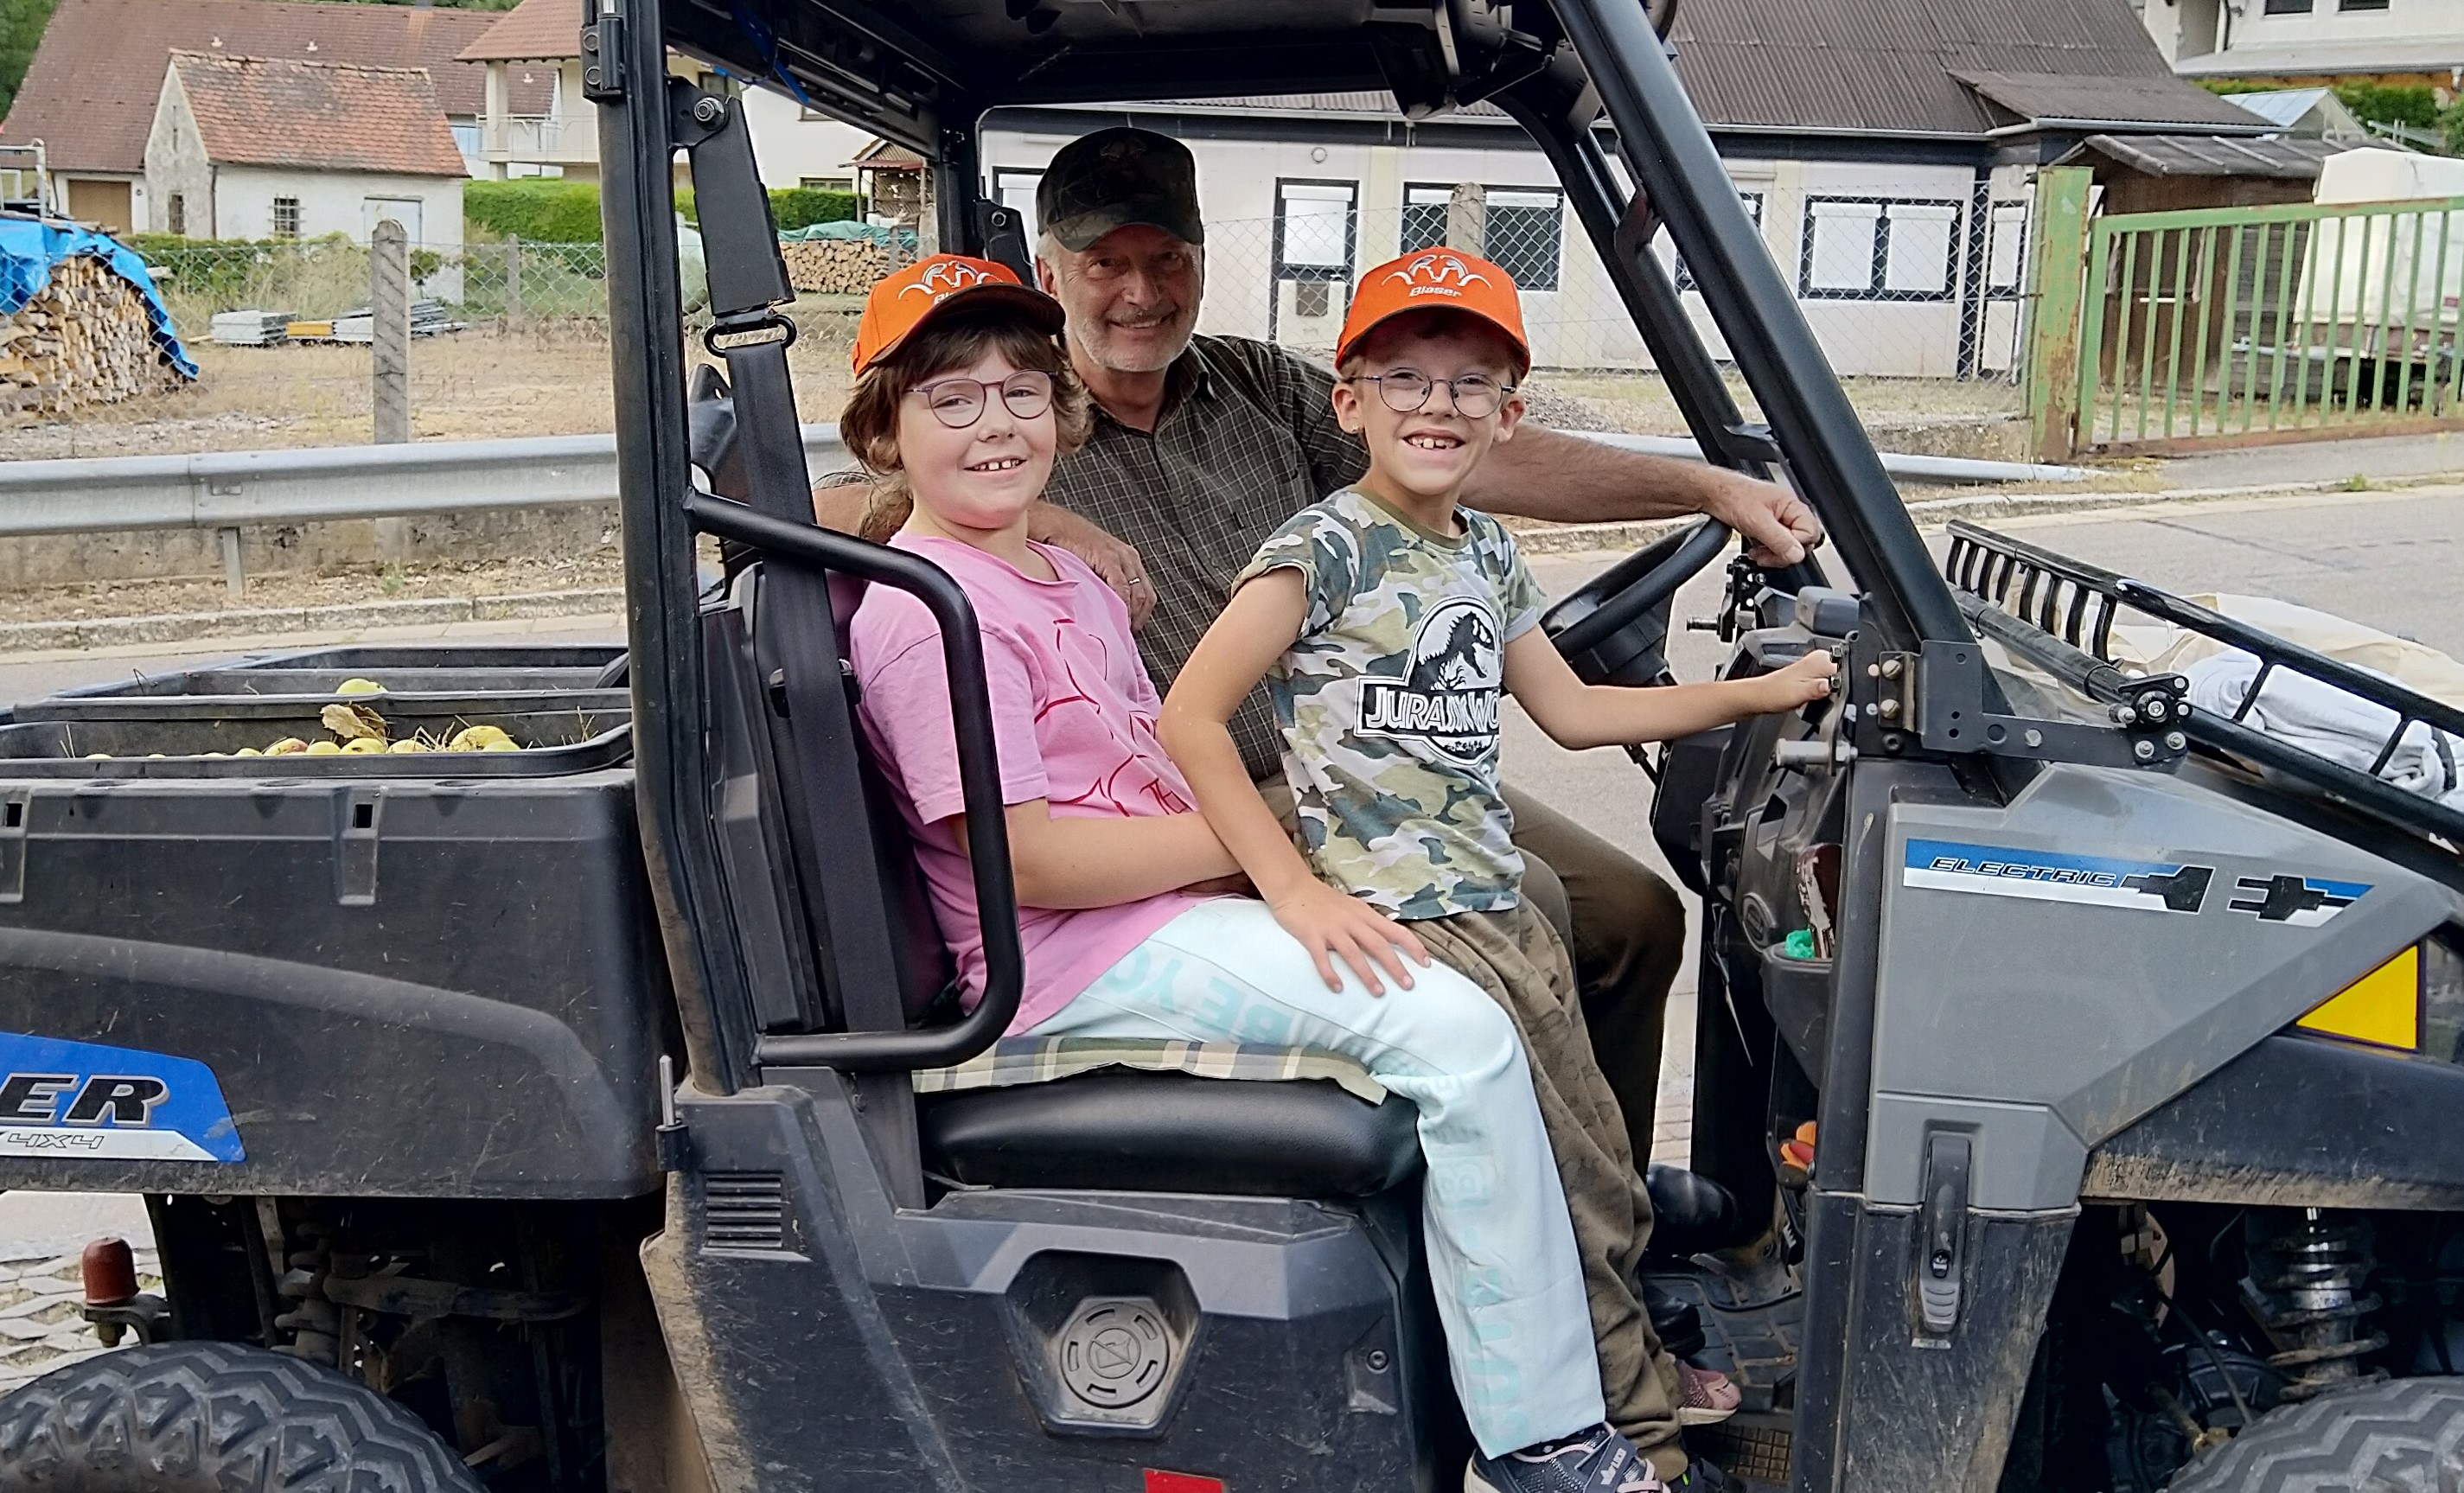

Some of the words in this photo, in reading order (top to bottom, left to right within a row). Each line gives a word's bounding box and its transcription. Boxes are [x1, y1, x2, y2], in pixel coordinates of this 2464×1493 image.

[1408, 286, 1462, 297] Blaser
[1929, 856, 2116, 887] ELECTRIC
[8, 1133, 105, 1150] 4X4
